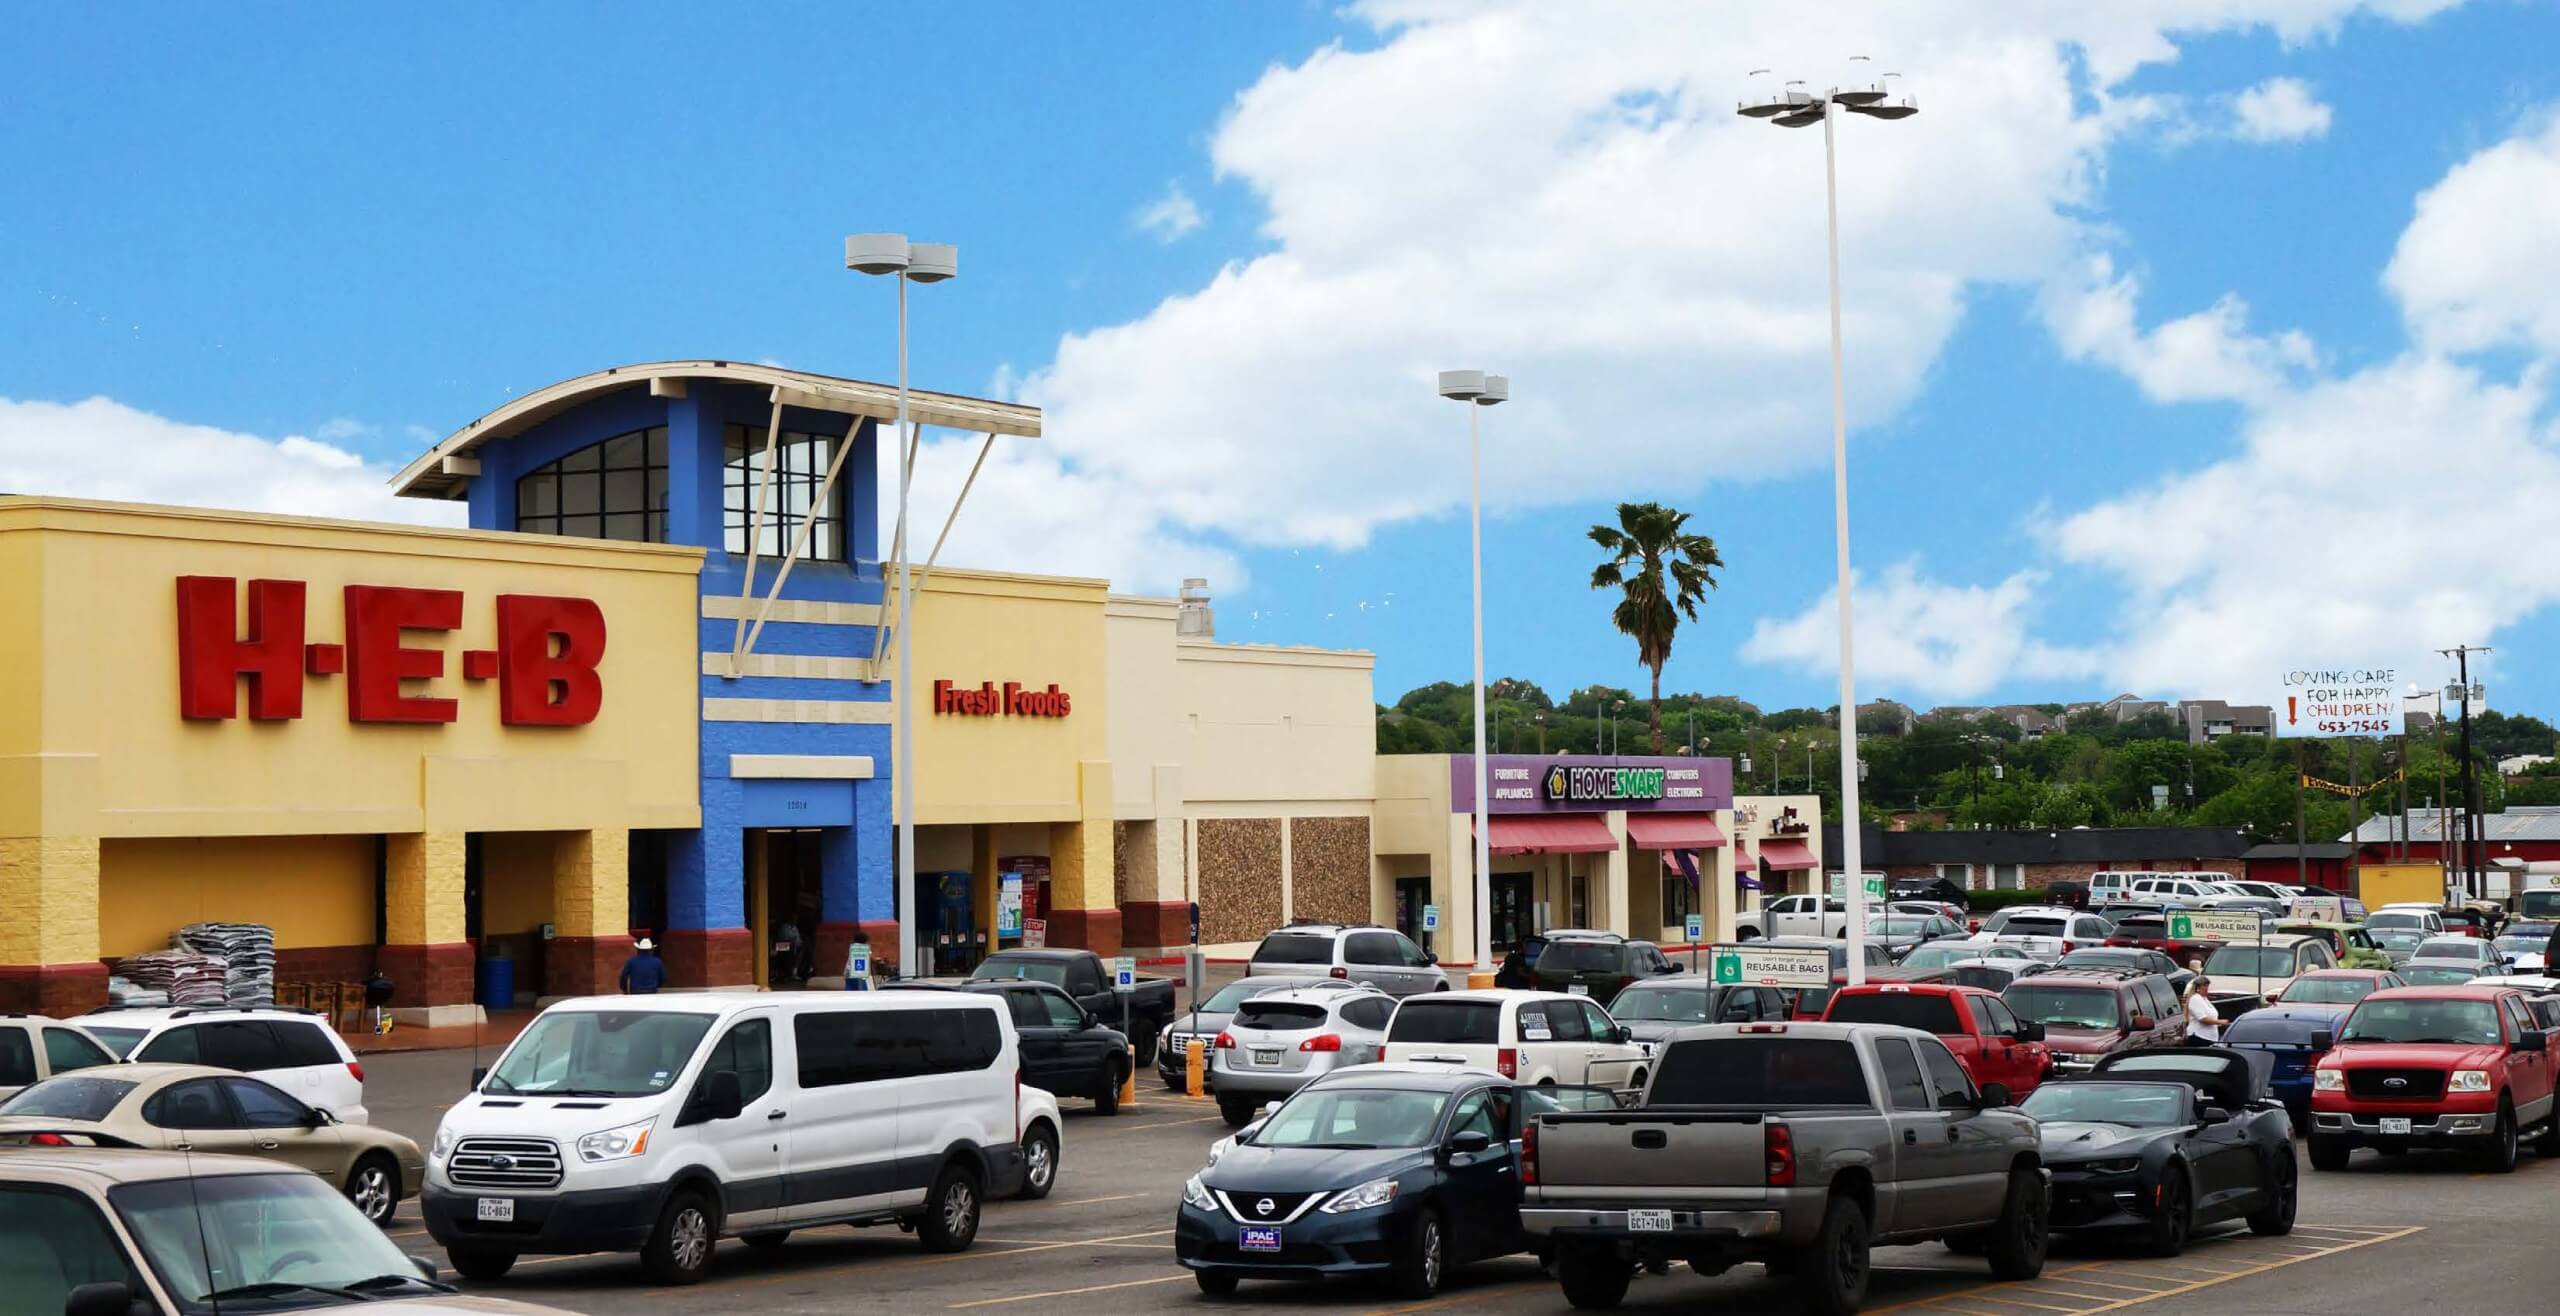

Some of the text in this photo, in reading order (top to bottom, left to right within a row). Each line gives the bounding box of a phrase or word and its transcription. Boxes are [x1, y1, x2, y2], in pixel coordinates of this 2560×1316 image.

[176, 575, 607, 726] H-E-B
[2283, 669, 2395, 686] LOVING CARE
[934, 680, 1071, 717] Fresh Foods
[2307, 687, 2392, 702] FOR HAPPY
[2306, 702, 2395, 717] CHILDREN!
[2318, 720, 2390, 733] 653-7545
[1495, 768, 1529, 780] FURNITURE
[1666, 769, 1699, 780] COMPUTERS
[1495, 788, 1534, 799] APPLIANCES
[1667, 787, 1703, 797] ELECTRONICS
[1029, 921, 1044, 929] STOP
[2195, 922, 2235, 930] REUSABLE
[1746, 963, 1824, 973] REUSABLE BAGS
[1247, 1231, 1274, 1240] IPAC
